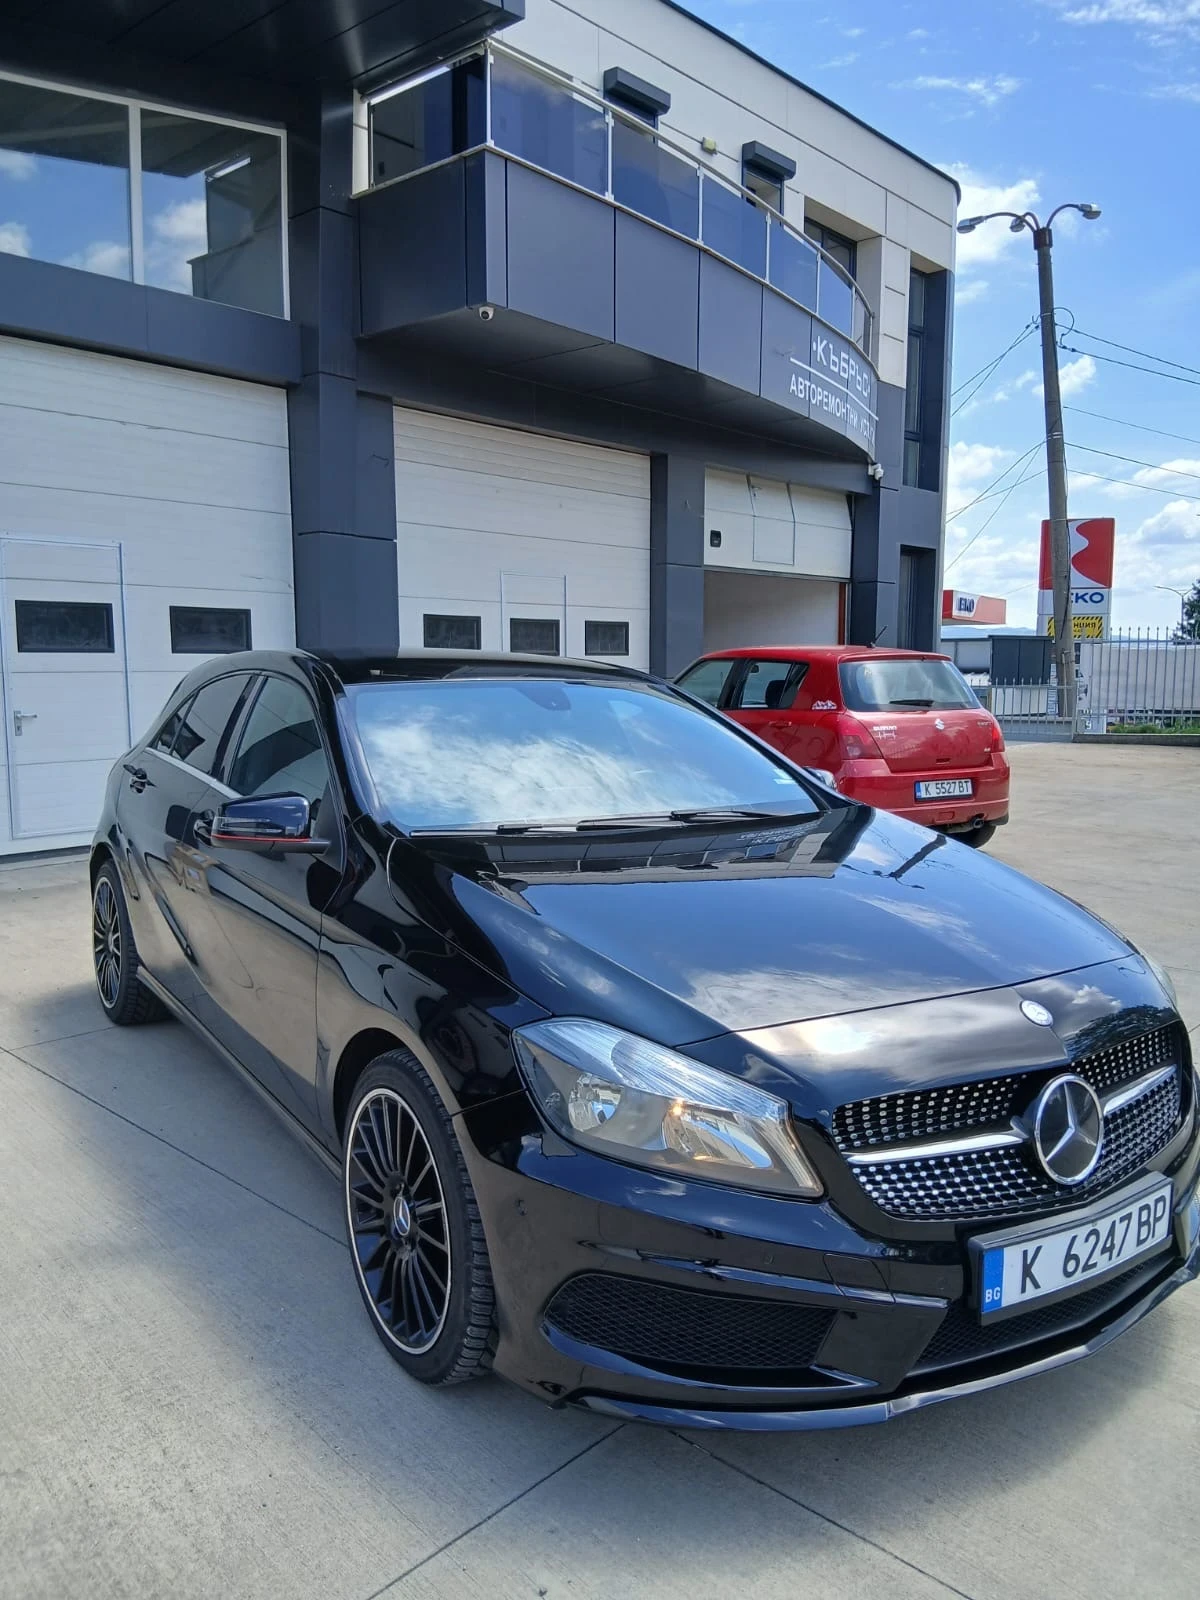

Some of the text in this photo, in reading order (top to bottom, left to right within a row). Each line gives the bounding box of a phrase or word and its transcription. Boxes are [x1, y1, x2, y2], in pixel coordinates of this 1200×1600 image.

[924, 783, 932, 796] K
[935, 781, 957, 795] 5527
[958, 780, 970, 793] BT
[1020, 1194, 1167, 1295] K 6247 BP
[984, 1286, 1001, 1304] BG
